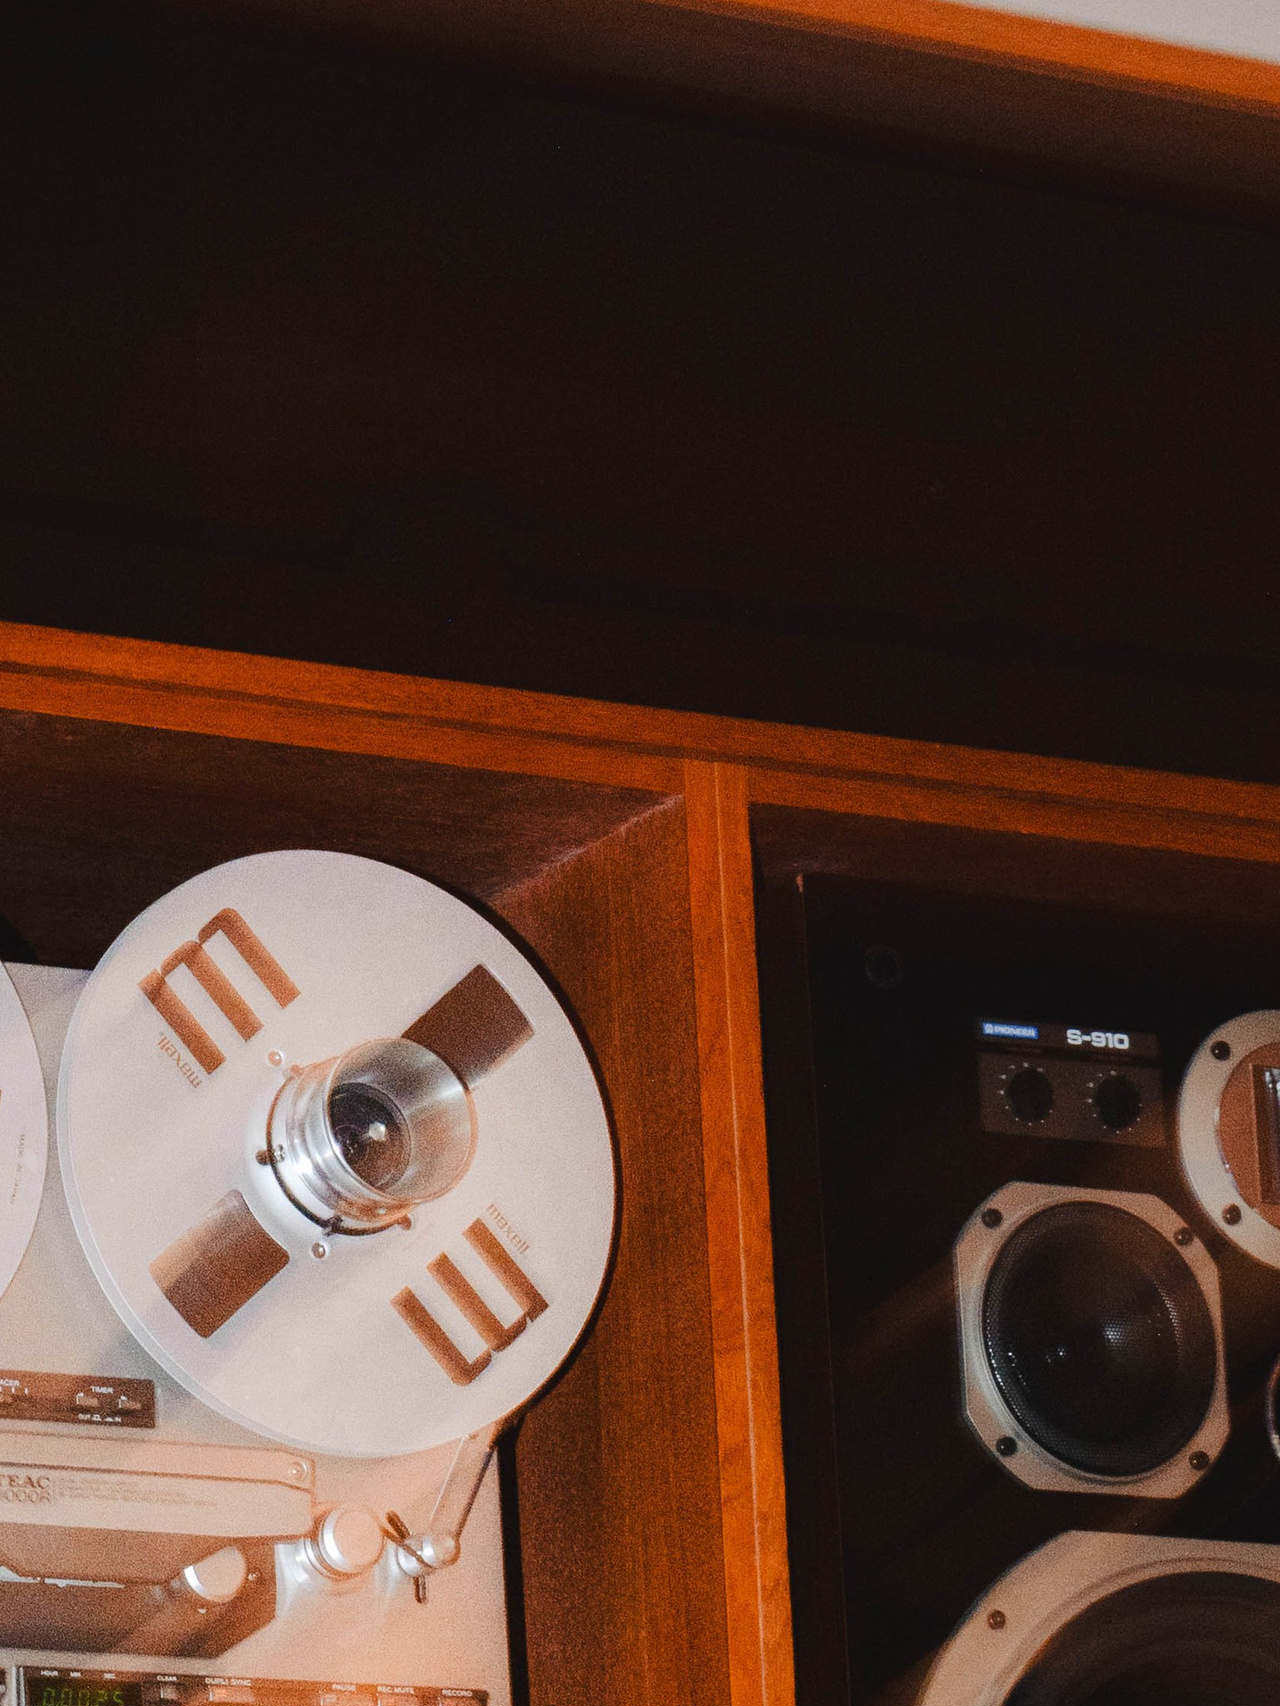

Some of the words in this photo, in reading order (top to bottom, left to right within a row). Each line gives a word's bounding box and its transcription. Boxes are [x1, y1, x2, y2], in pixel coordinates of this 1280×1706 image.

[994, 1023, 1037, 1038] PIONEER
[1066, 1029, 1130, 1050] S-910
[158, 1035, 202, 1088] maxell
[485, 1203, 530, 1255] maxell
[90, 1385, 114, 1394] TIMER
[231, 1679, 252, 1687] SYNC
[377, 1686, 393, 1694] REC
[394, 1687, 415, 1695] MUTE
[442, 1689, 473, 1698] RECORD
